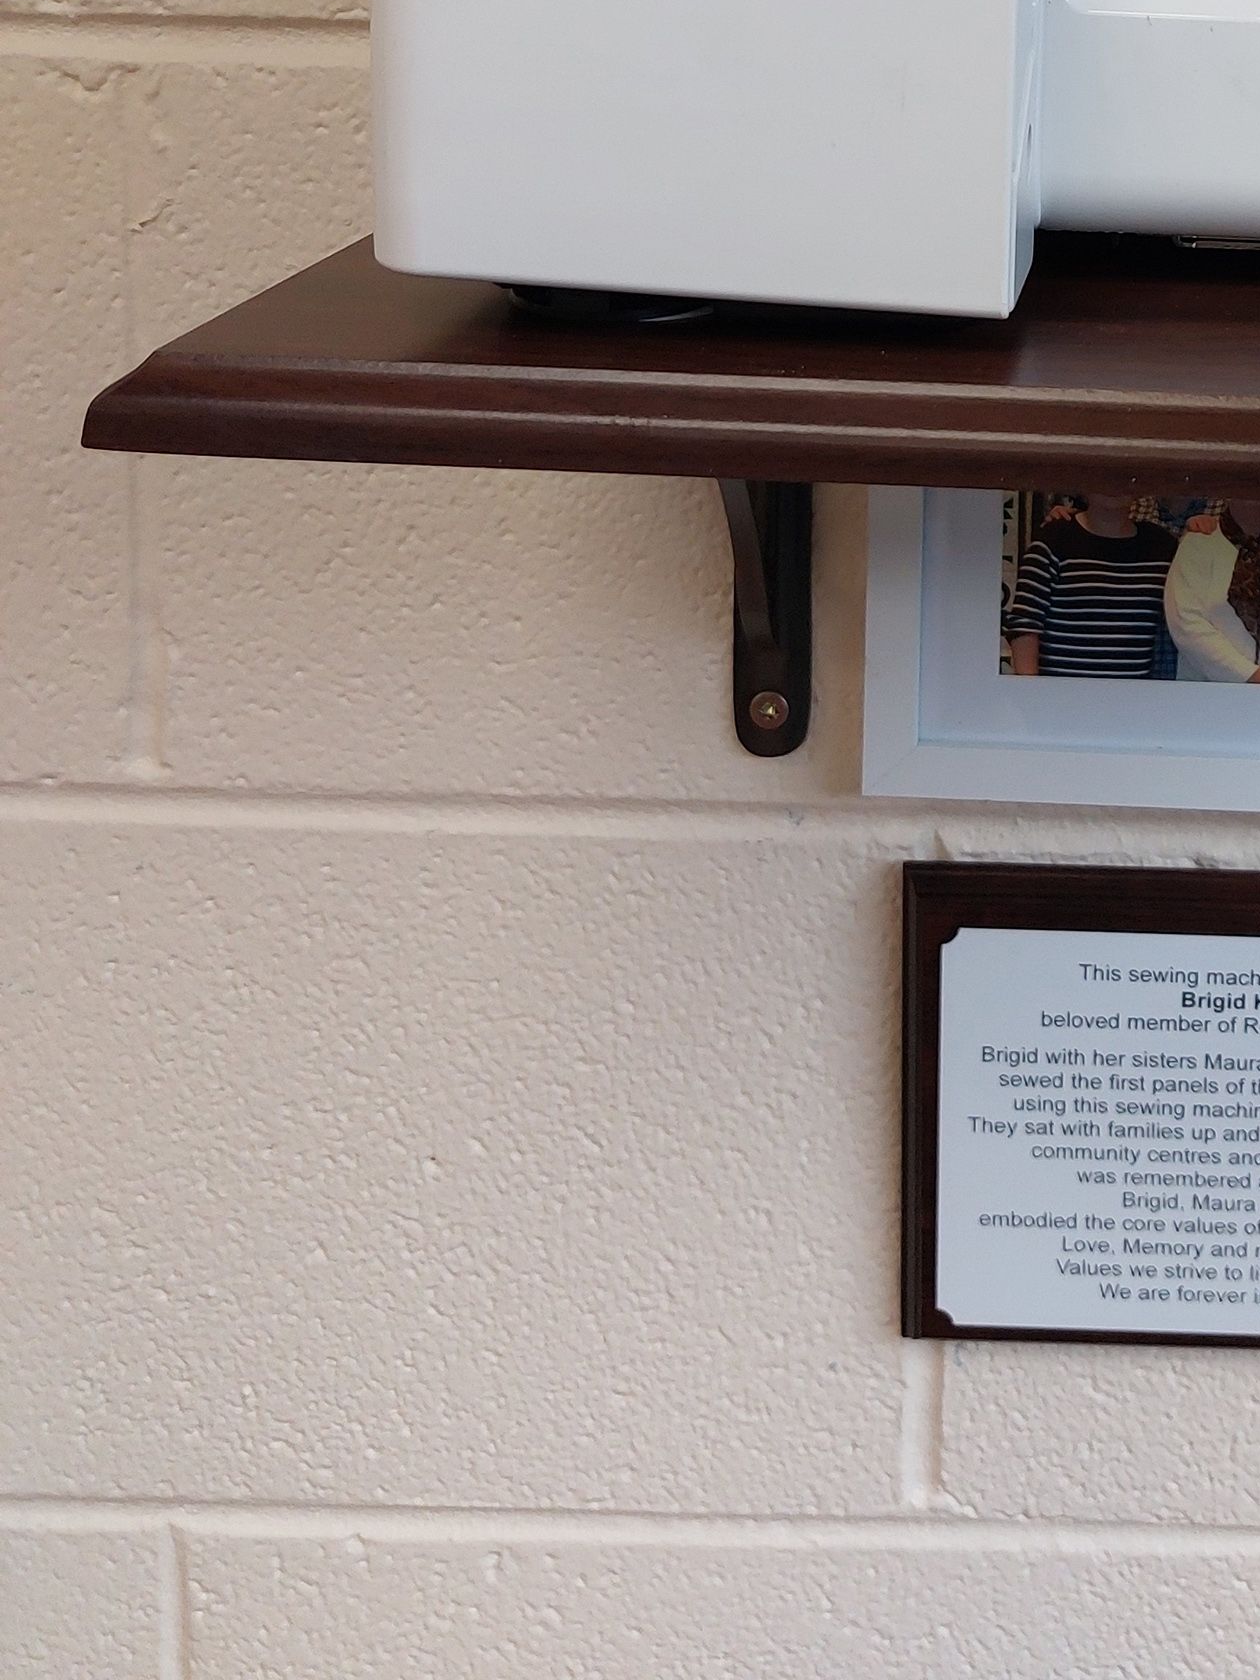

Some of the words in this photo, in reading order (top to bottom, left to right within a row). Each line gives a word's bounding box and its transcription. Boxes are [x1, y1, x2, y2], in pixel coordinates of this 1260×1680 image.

[1078, 963, 1121, 981] This
[1128, 966, 1198, 988] sewing
[1181, 991, 1245, 1013] Brigid
[1041, 1010, 1119, 1029] beloved
[1127, 1014, 1211, 1032] member
[1217, 1016, 1237, 1033] of
[982, 1046, 1038, 1067] Brigid
[1045, 1048, 1085, 1065] with
[1093, 1049, 1125, 1067] her
[1132, 1050, 1197, 1069] sisters
[998, 1072, 1063, 1088] sewed
[1071, 1072, 1102, 1089] the
[1109, 1073, 1145, 1091] first
[1152, 1077, 1218, 1095] panels
[1225, 1078, 1245, 1094] of
[1013, 1095, 1065, 1116] using
[1073, 1096, 1108, 1113] this
[1115, 1098, 1185, 1120] sewing
[967, 1116, 1017, 1138] They
[1025, 1120, 1054, 1135] sat
[1060, 1120, 1100, 1137] with
[1107, 1120, 1184, 1139] families
[1192, 1128, 1216, 1144] up
[1223, 1126, 1259, 1142] and
[1031, 1146, 1140, 1165] community
[1147, 1149, 1221, 1164] centres
[1077, 1171, 1116, 1184] was
[1124, 1171, 1250, 1188] remembered
[1122, 1191, 1183, 1213] Brigid,
[1192, 1193, 1255, 1212] Maura
[979, 1211, 1077, 1229] embodied
[1084, 1213, 1115, 1230] the
[1122, 1218, 1165, 1232] core
[1173, 1216, 1237, 1235] values
[1062, 1235, 1114, 1255] Love,
[1123, 1238, 1203, 1260] Memory
[1211, 1242, 1247, 1258] and
[1056, 1258, 1122, 1276] Values
[1129, 1265, 1157, 1278] we
[1164, 1264, 1217, 1280] strive
[1224, 1265, 1242, 1281] to
[1099, 1283, 1131, 1299] We
[1138, 1288, 1170, 1301] are
[1177, 1285, 1246, 1303] forever
